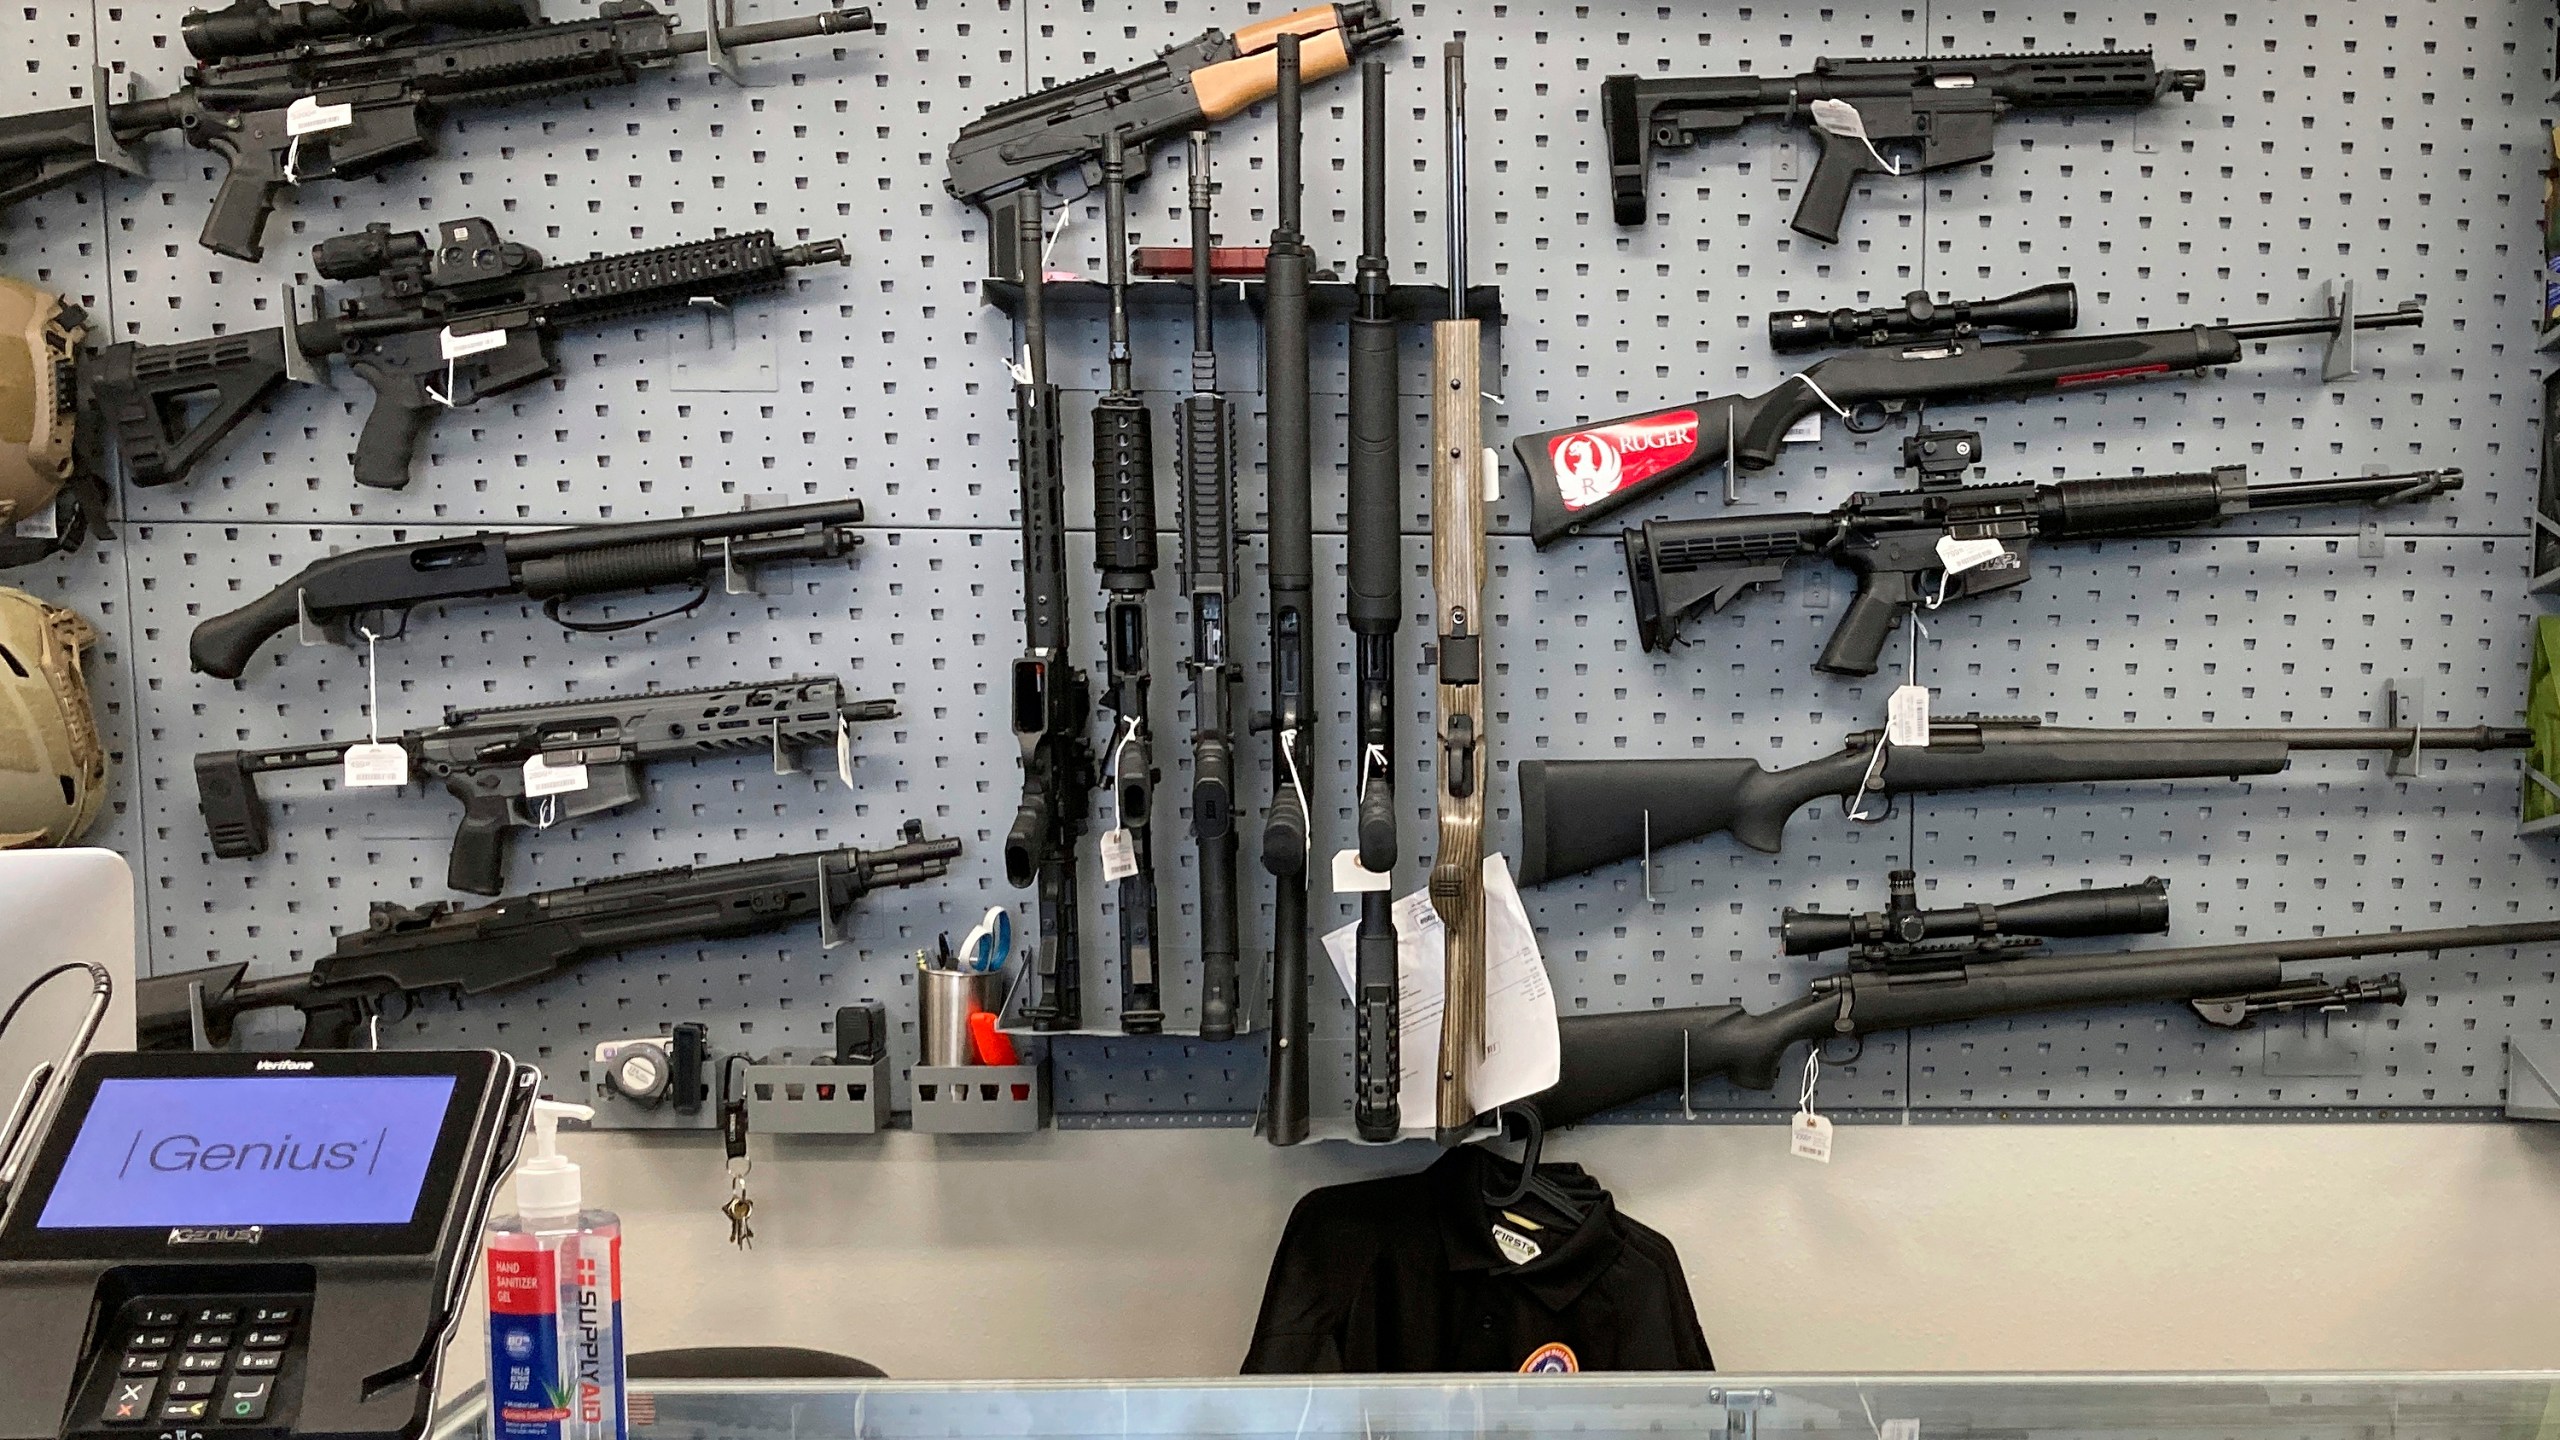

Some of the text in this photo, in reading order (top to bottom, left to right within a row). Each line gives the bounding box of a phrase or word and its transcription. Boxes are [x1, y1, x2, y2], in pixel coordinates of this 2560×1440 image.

[1618, 427, 1693, 454] RUGER
[1582, 478, 1600, 495] R
[256, 1060, 314, 1071] Verifone
[150, 1134, 357, 1172] Genius
[1493, 1229, 1527, 1249] FIRST
[496, 1261, 520, 1273] HAND
[496, 1276, 538, 1289] SANITIZER
[497, 1290, 511, 1303] GEL
[510, 1381, 529, 1391] FAST
